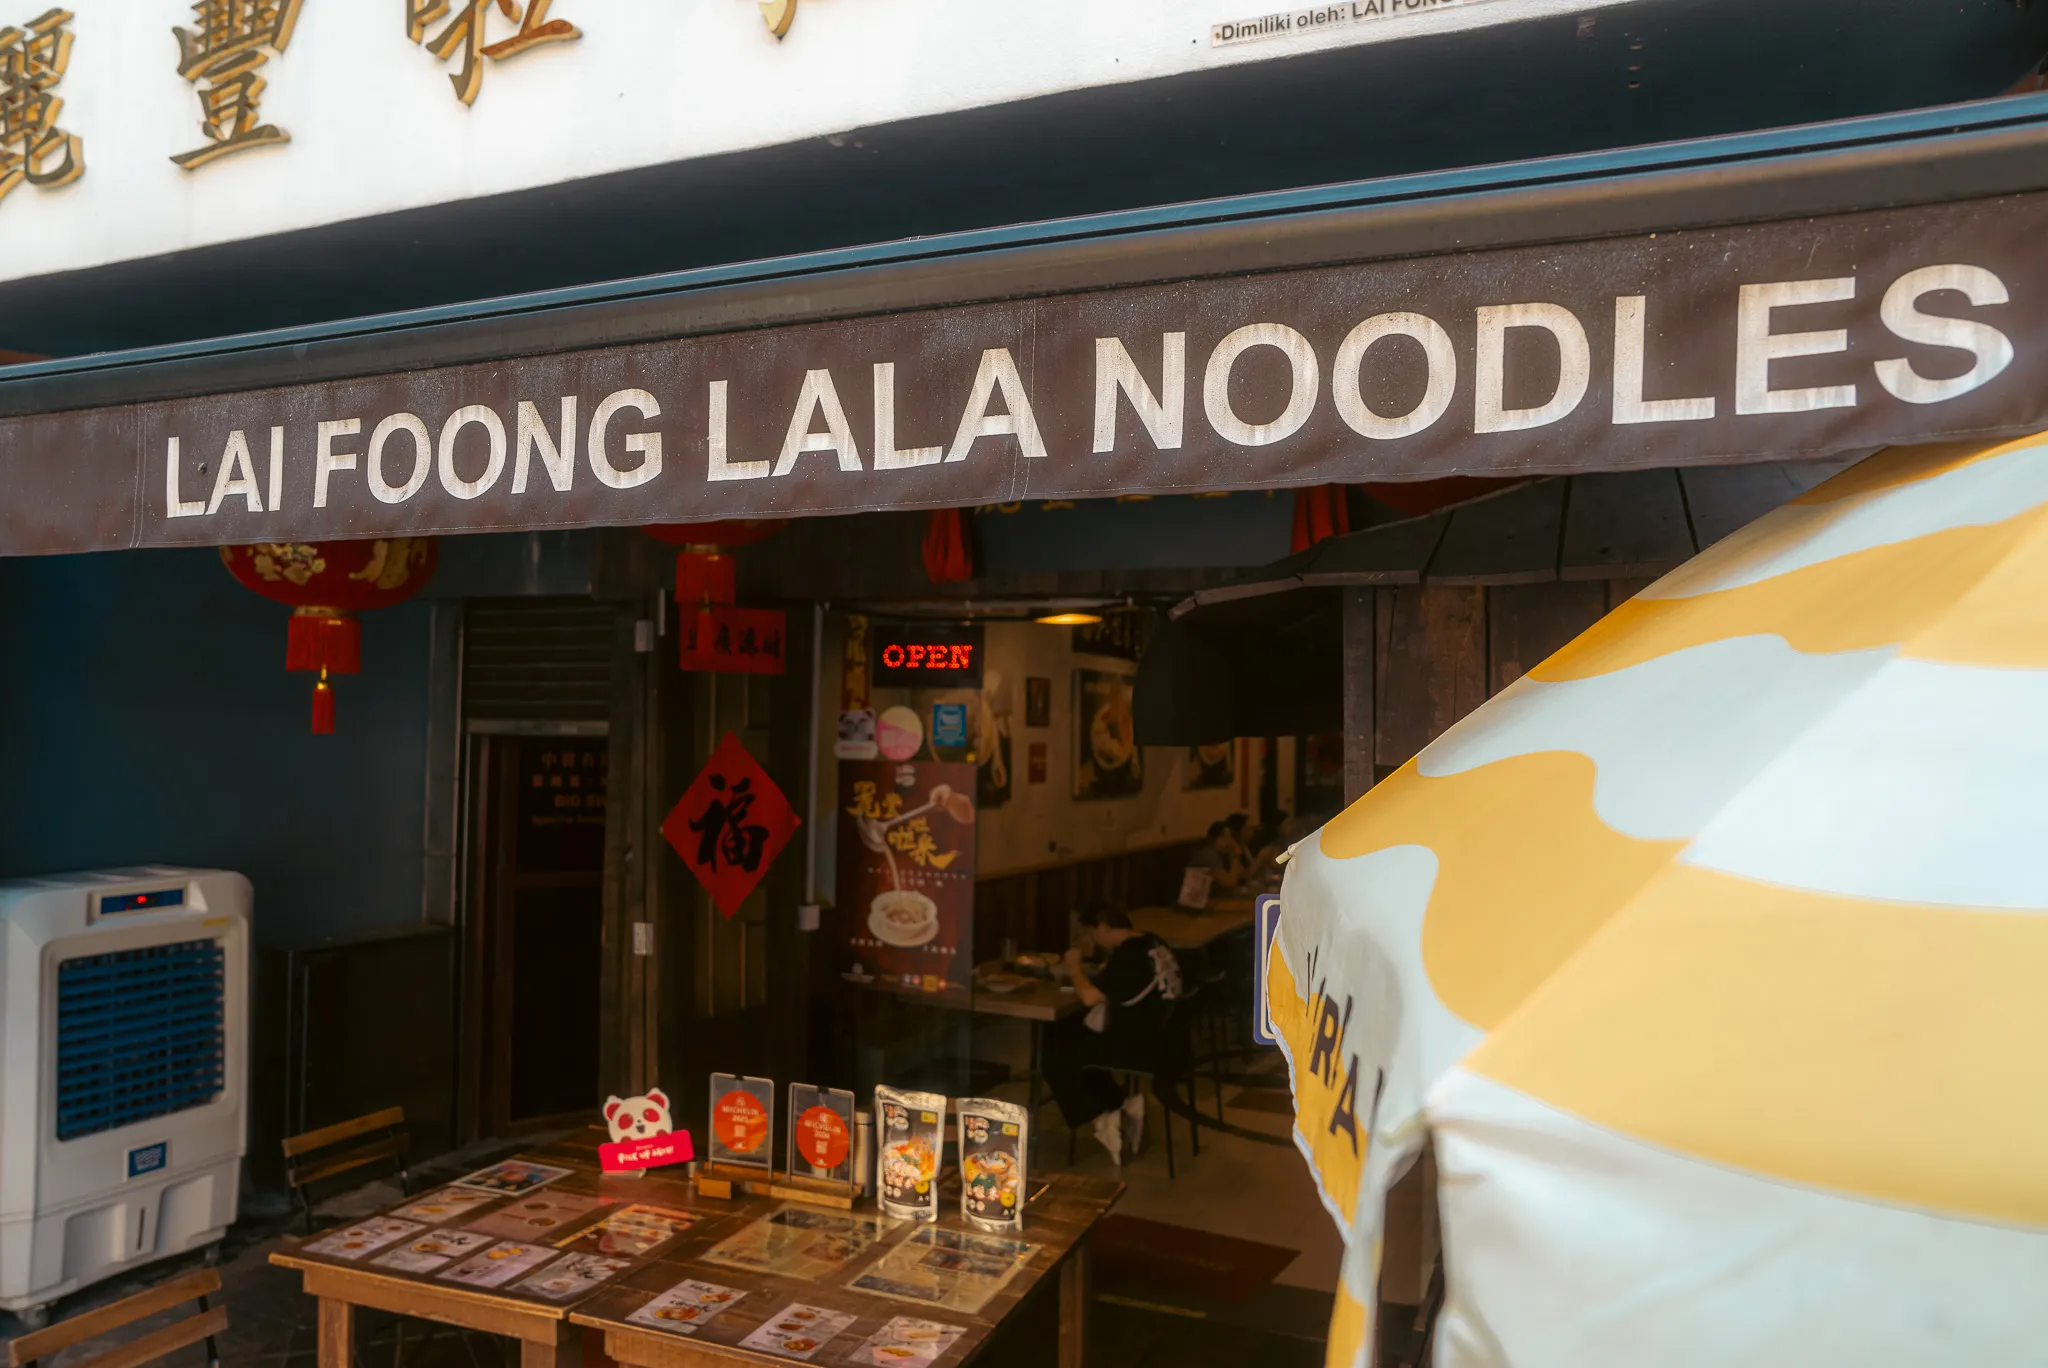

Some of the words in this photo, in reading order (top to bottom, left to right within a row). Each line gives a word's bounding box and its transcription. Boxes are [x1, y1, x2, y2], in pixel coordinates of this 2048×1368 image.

[1221, 14, 1291, 41] Dimiliki
[1296, 6, 1346, 28] oleh:
[1351, 0, 1385, 18] LAI
[165, 426, 284, 519] LAI
[312, 387, 663, 508] FOONG
[706, 348, 1048, 482] LALA
[1091, 263, 2015, 454] NOODLES
[882, 644, 973, 669] OPEN
[688, 773, 771, 873] 福
[721, 1104, 760, 1116] MICHELIN
[804, 1118, 842, 1134] MICHELIN
